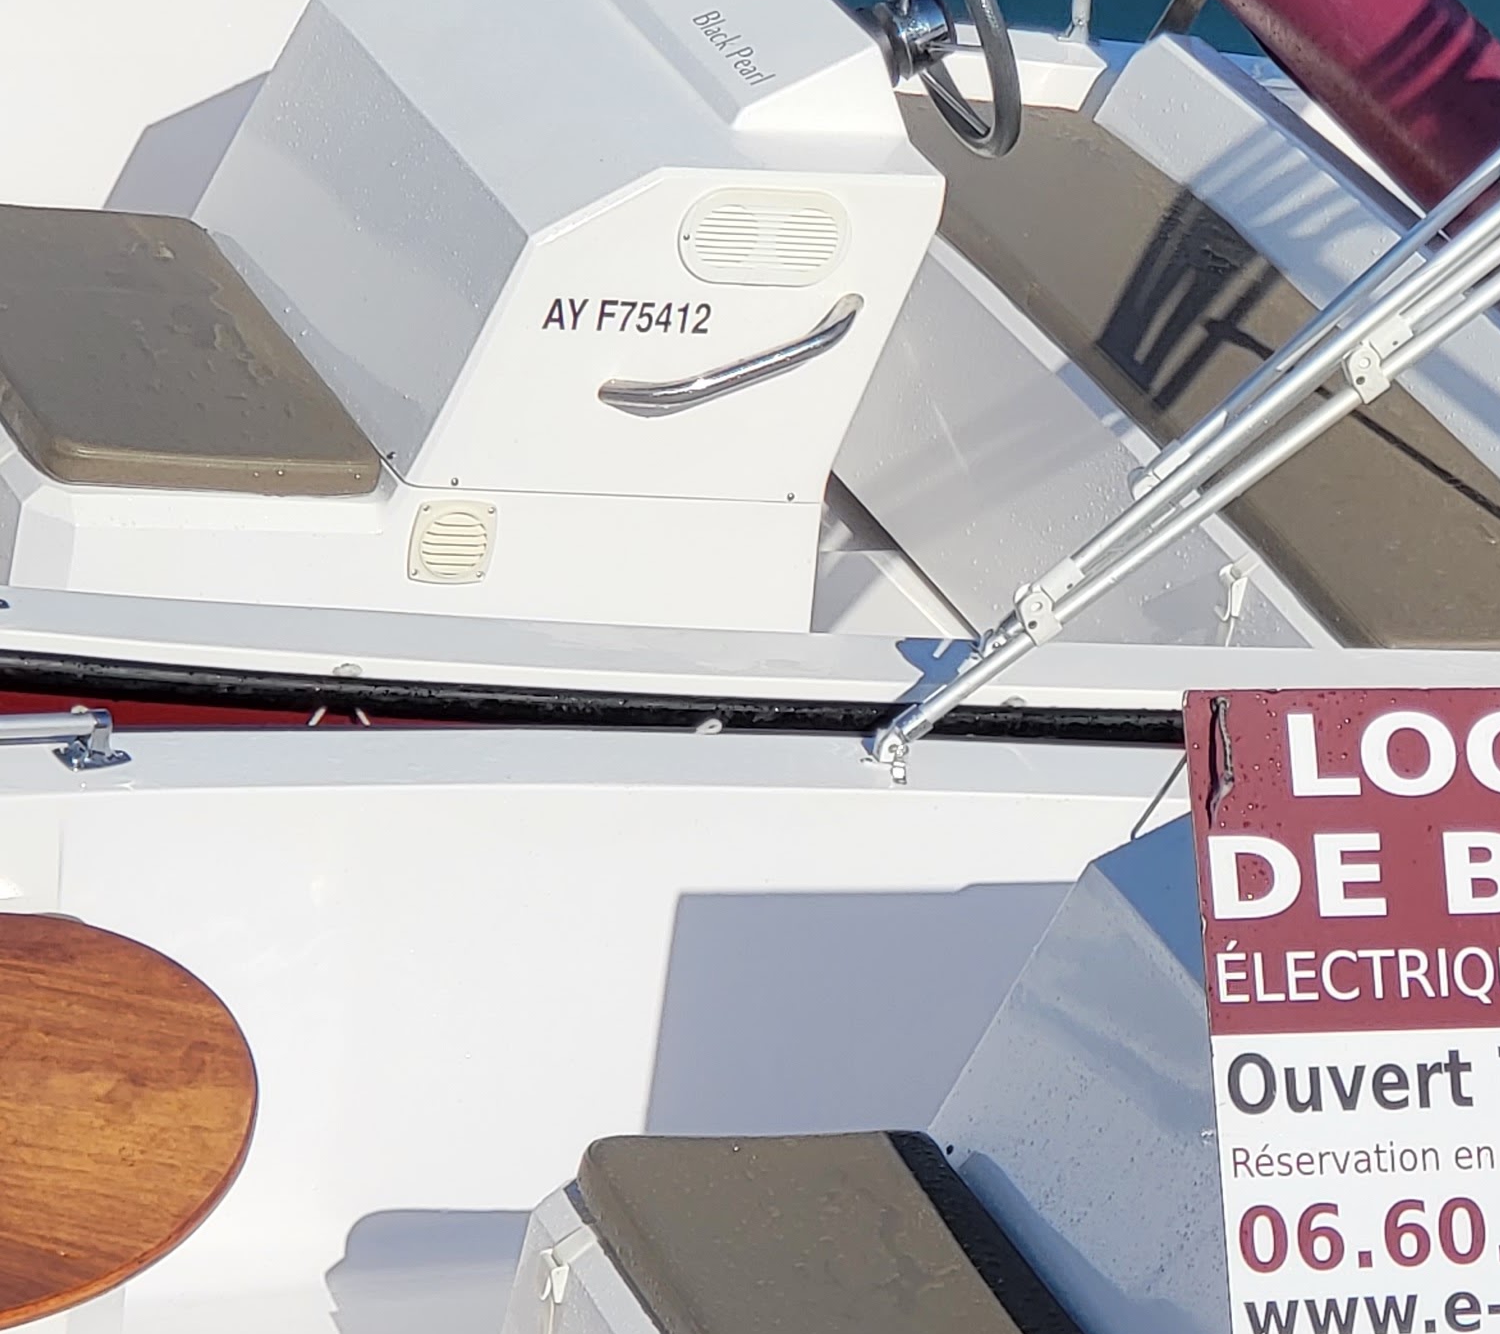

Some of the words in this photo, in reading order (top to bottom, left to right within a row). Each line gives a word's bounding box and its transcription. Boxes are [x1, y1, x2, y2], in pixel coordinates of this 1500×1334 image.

[692, 10, 742, 51] Black
[725, 46, 776, 86] Pearl
[542, 298, 589, 330] AY
[596, 299, 712, 334] F75412
[1207, 832, 1387, 920] DE
[1227, 1049, 1474, 1115] Ouvert
[1232, 1143, 1440, 1178] Réservation
[1454, 1146, 1495, 1170] en
